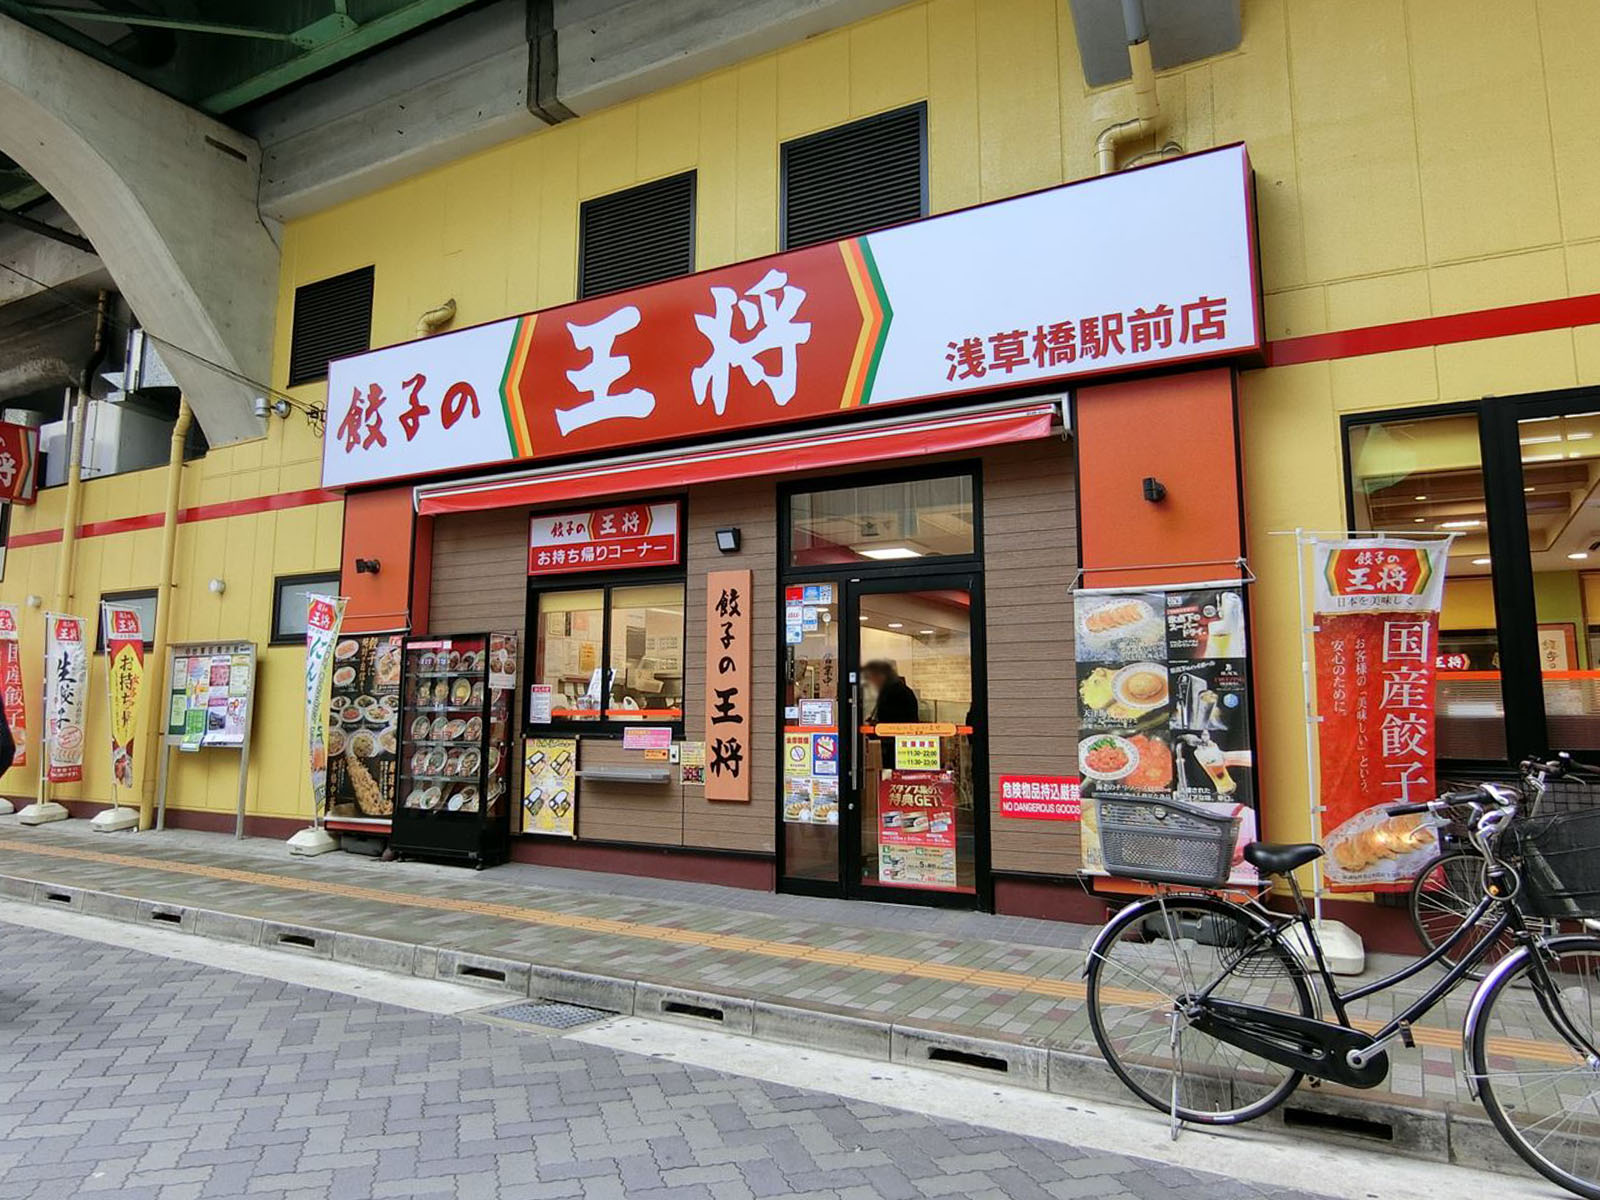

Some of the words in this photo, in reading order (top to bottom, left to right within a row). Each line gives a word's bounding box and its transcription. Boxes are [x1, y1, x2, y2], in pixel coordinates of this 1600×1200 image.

[945, 296, 1227, 382] 浅草橋駅前店
[336, 373, 480, 453] 餃子の
[555, 268, 812, 437] 王将
[551, 521, 586, 538] 餃子の
[599, 511, 641, 535] 王将
[537, 542, 668, 566] お持ち帰りコーナー
[1354, 550, 1400, 565] 餃子の
[1344, 565, 1408, 592] 王将
[709, 588, 743, 778] 餃子の王将
[1378, 620, 1431, 803] 国産餃子
[1002, 801, 1013, 811] NO
[1013, 802, 1056, 813] DANGEROUS
[1055, 803, 1081, 814] GOODS
